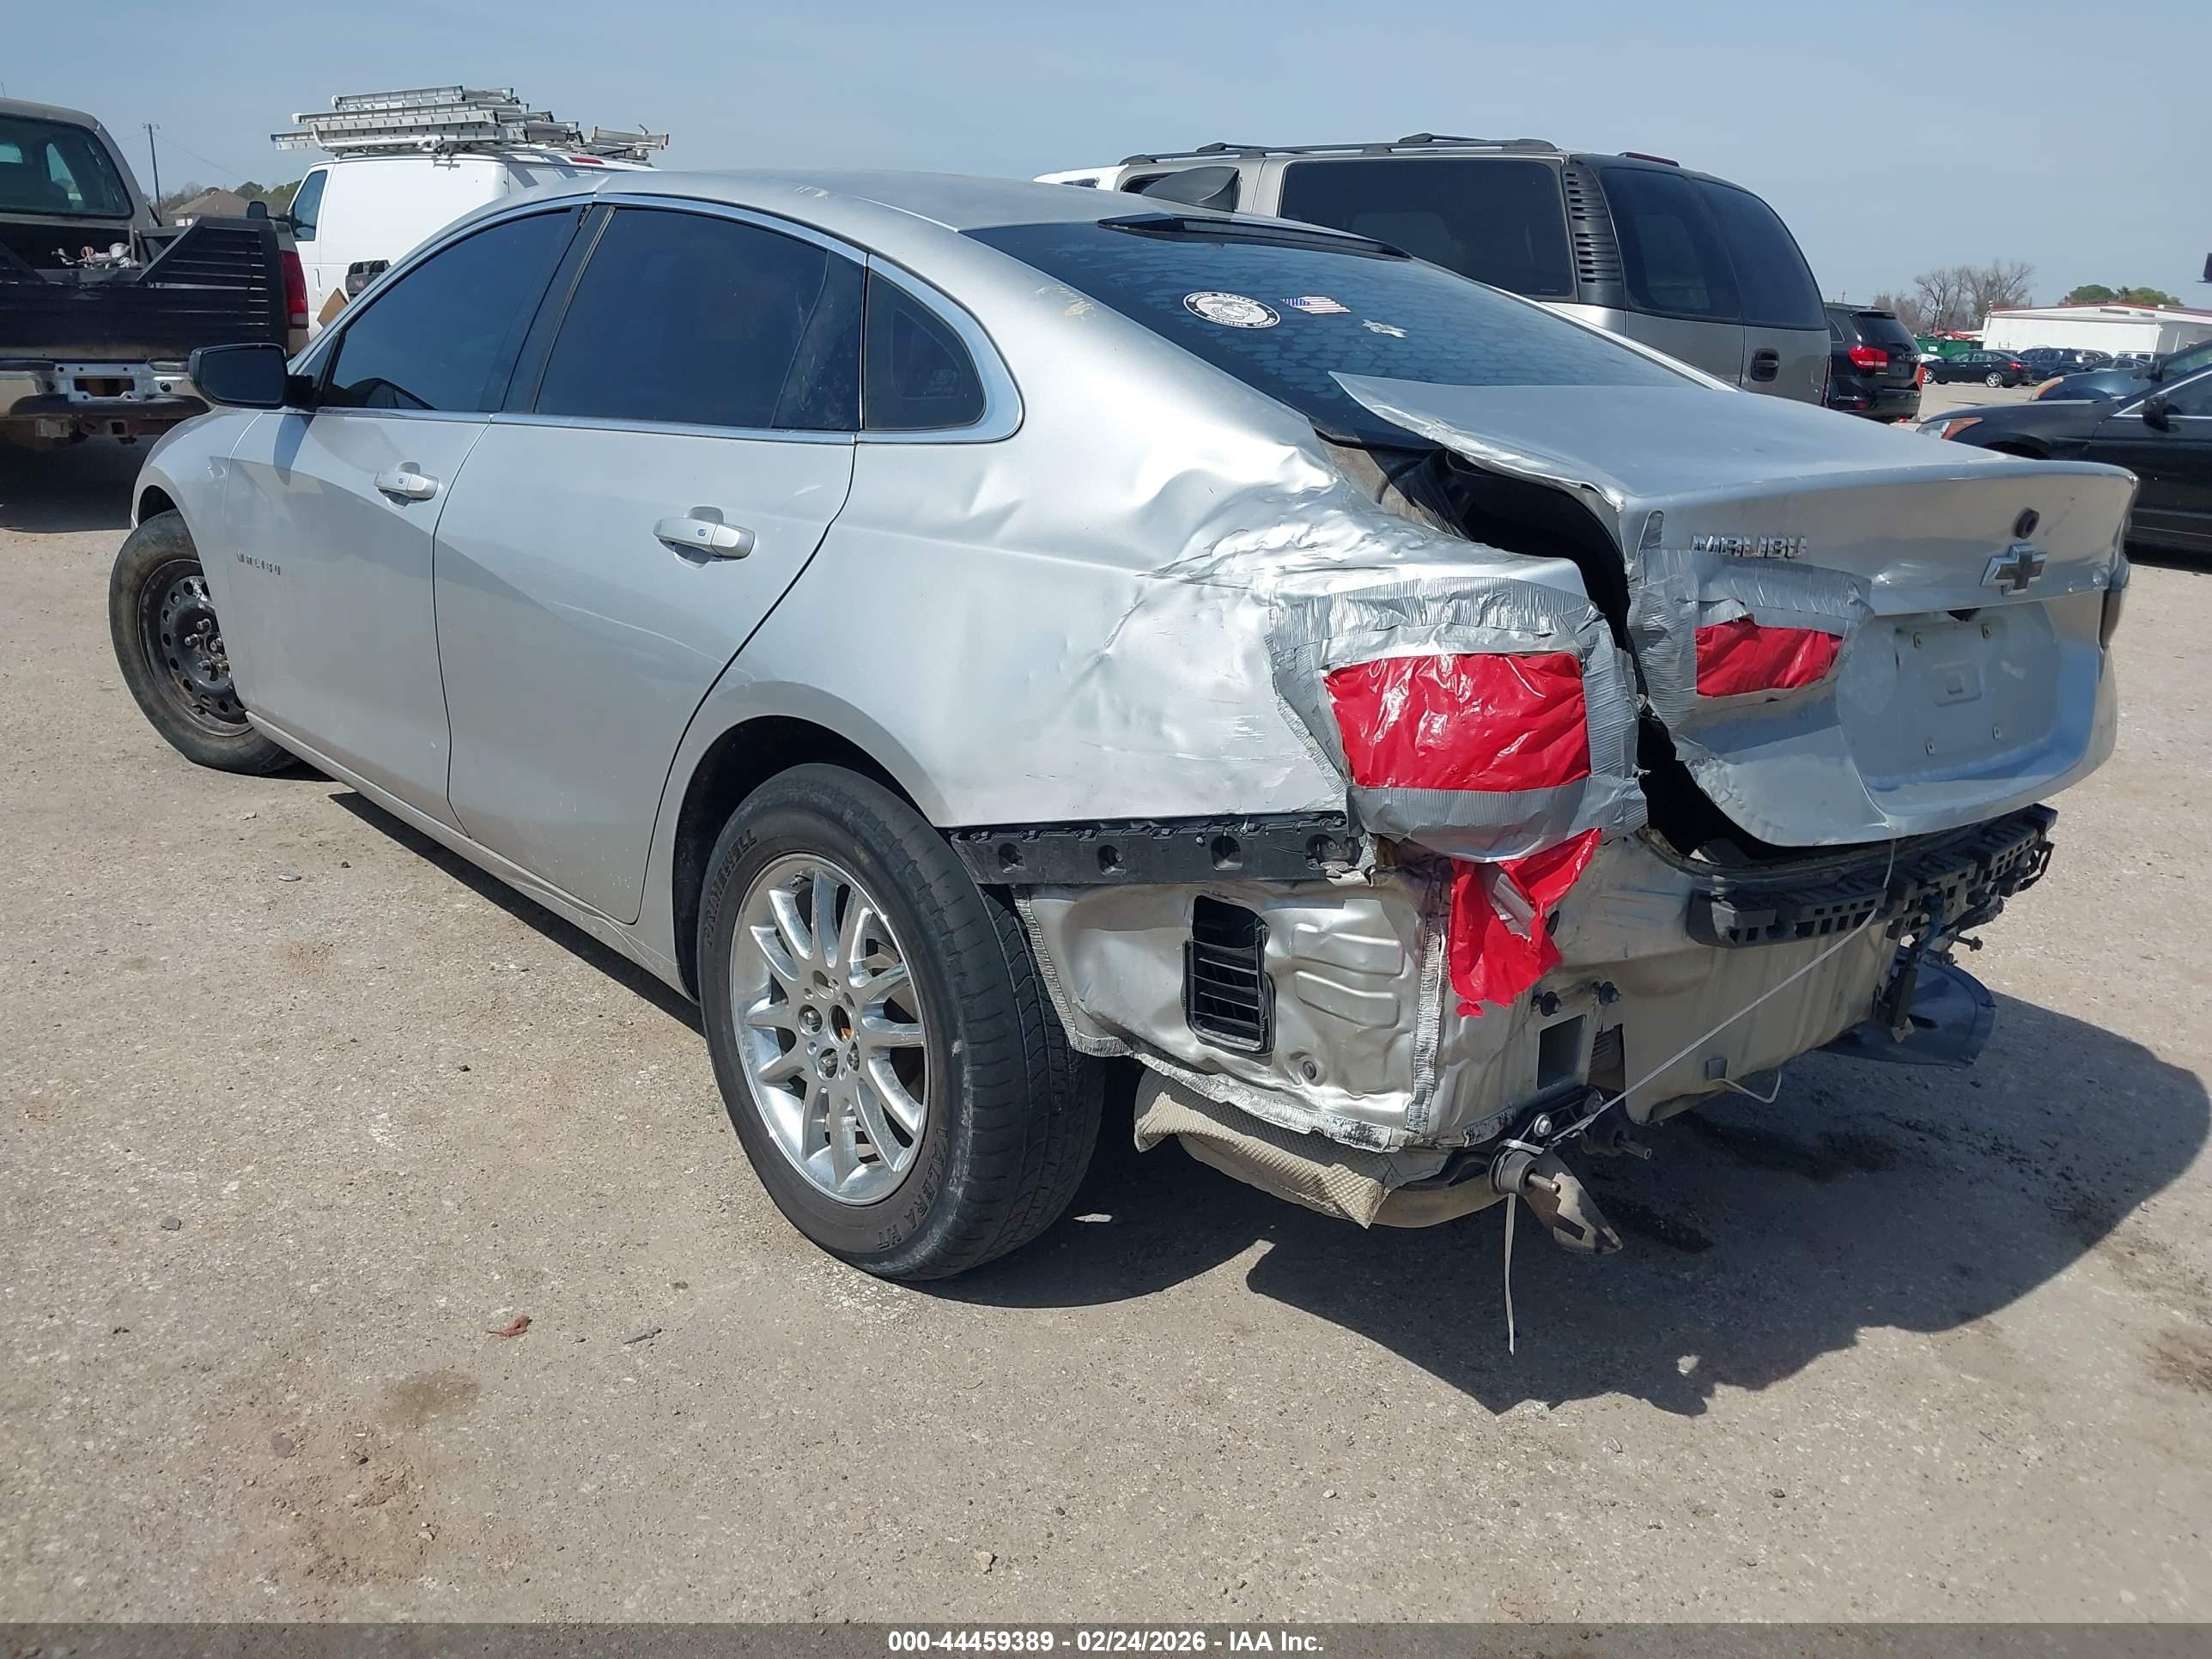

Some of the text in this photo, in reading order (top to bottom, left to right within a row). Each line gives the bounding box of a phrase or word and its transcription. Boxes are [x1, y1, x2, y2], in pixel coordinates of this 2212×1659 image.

[1691, 535, 1808, 559] MALIBU
[234, 550, 282, 576] MALIBU
[877, 1127, 949, 1250] VALERA HT
